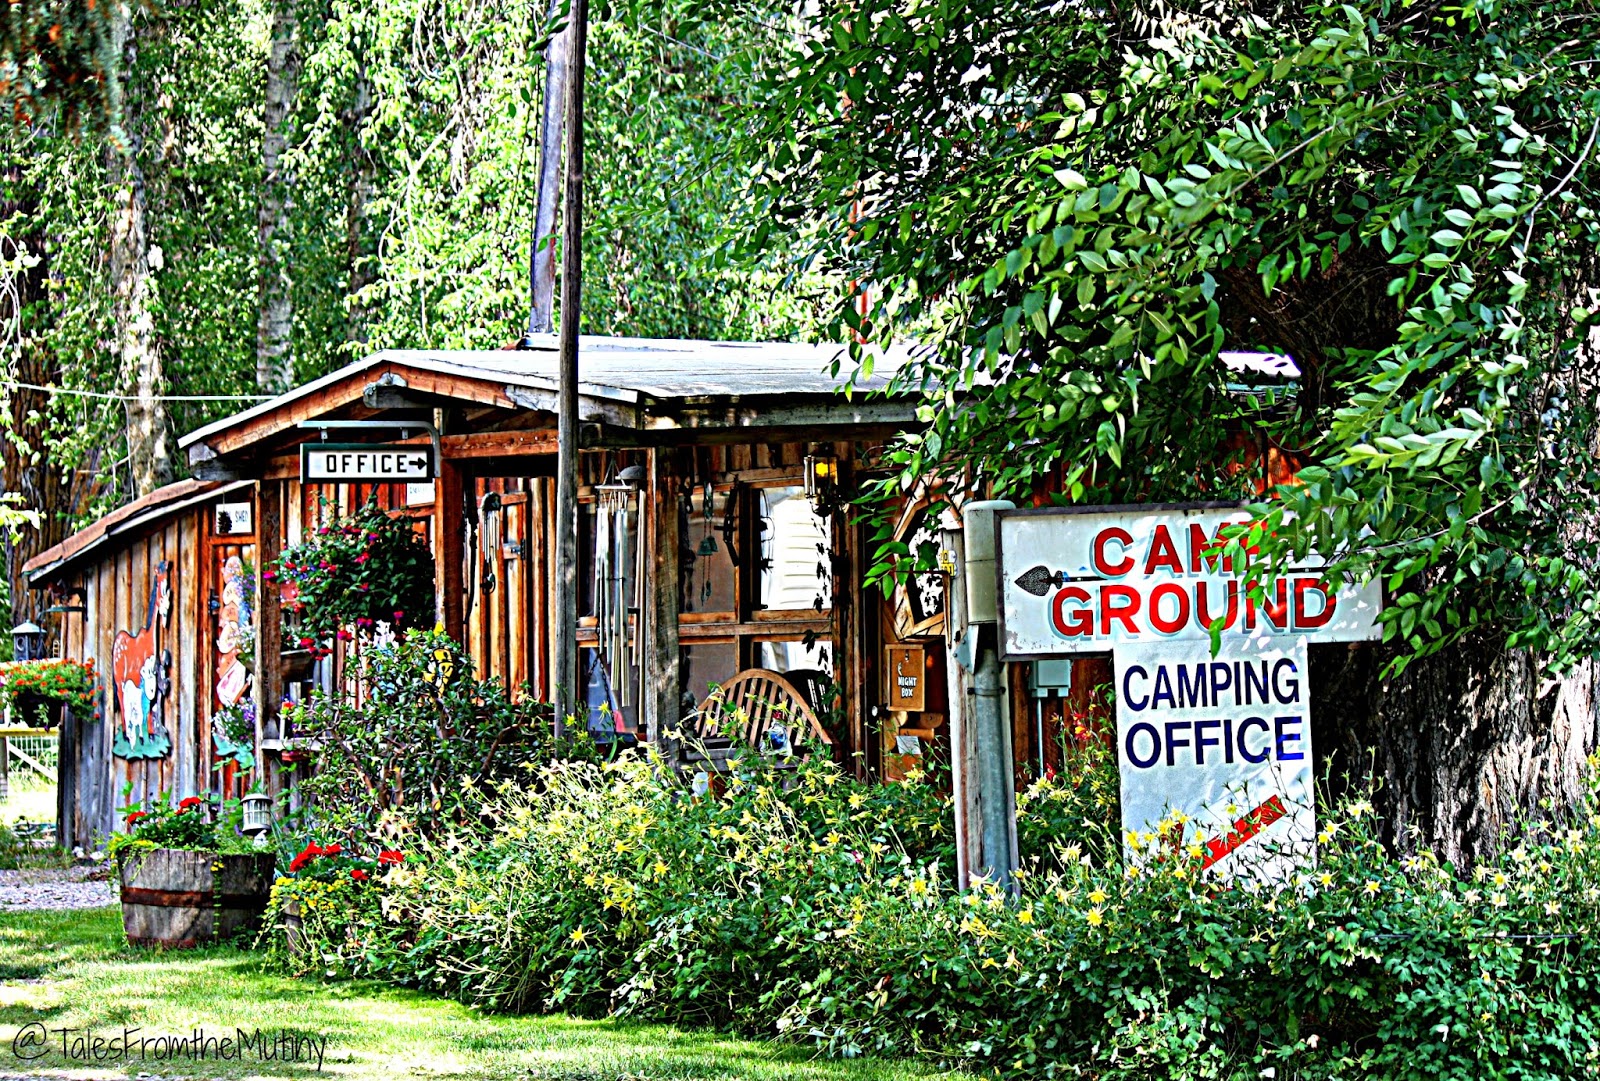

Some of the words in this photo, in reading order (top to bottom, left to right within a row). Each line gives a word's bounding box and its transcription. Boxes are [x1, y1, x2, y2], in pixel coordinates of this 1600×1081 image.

[326, 454, 408, 473] OFFICE
[1049, 577, 1338, 638] GROUND
[897, 676, 917, 687] NIGHT
[901, 687, 913, 697] BOX
[1122, 657, 1300, 711] CAMPING
[1125, 716, 1305, 769] OFFICE
